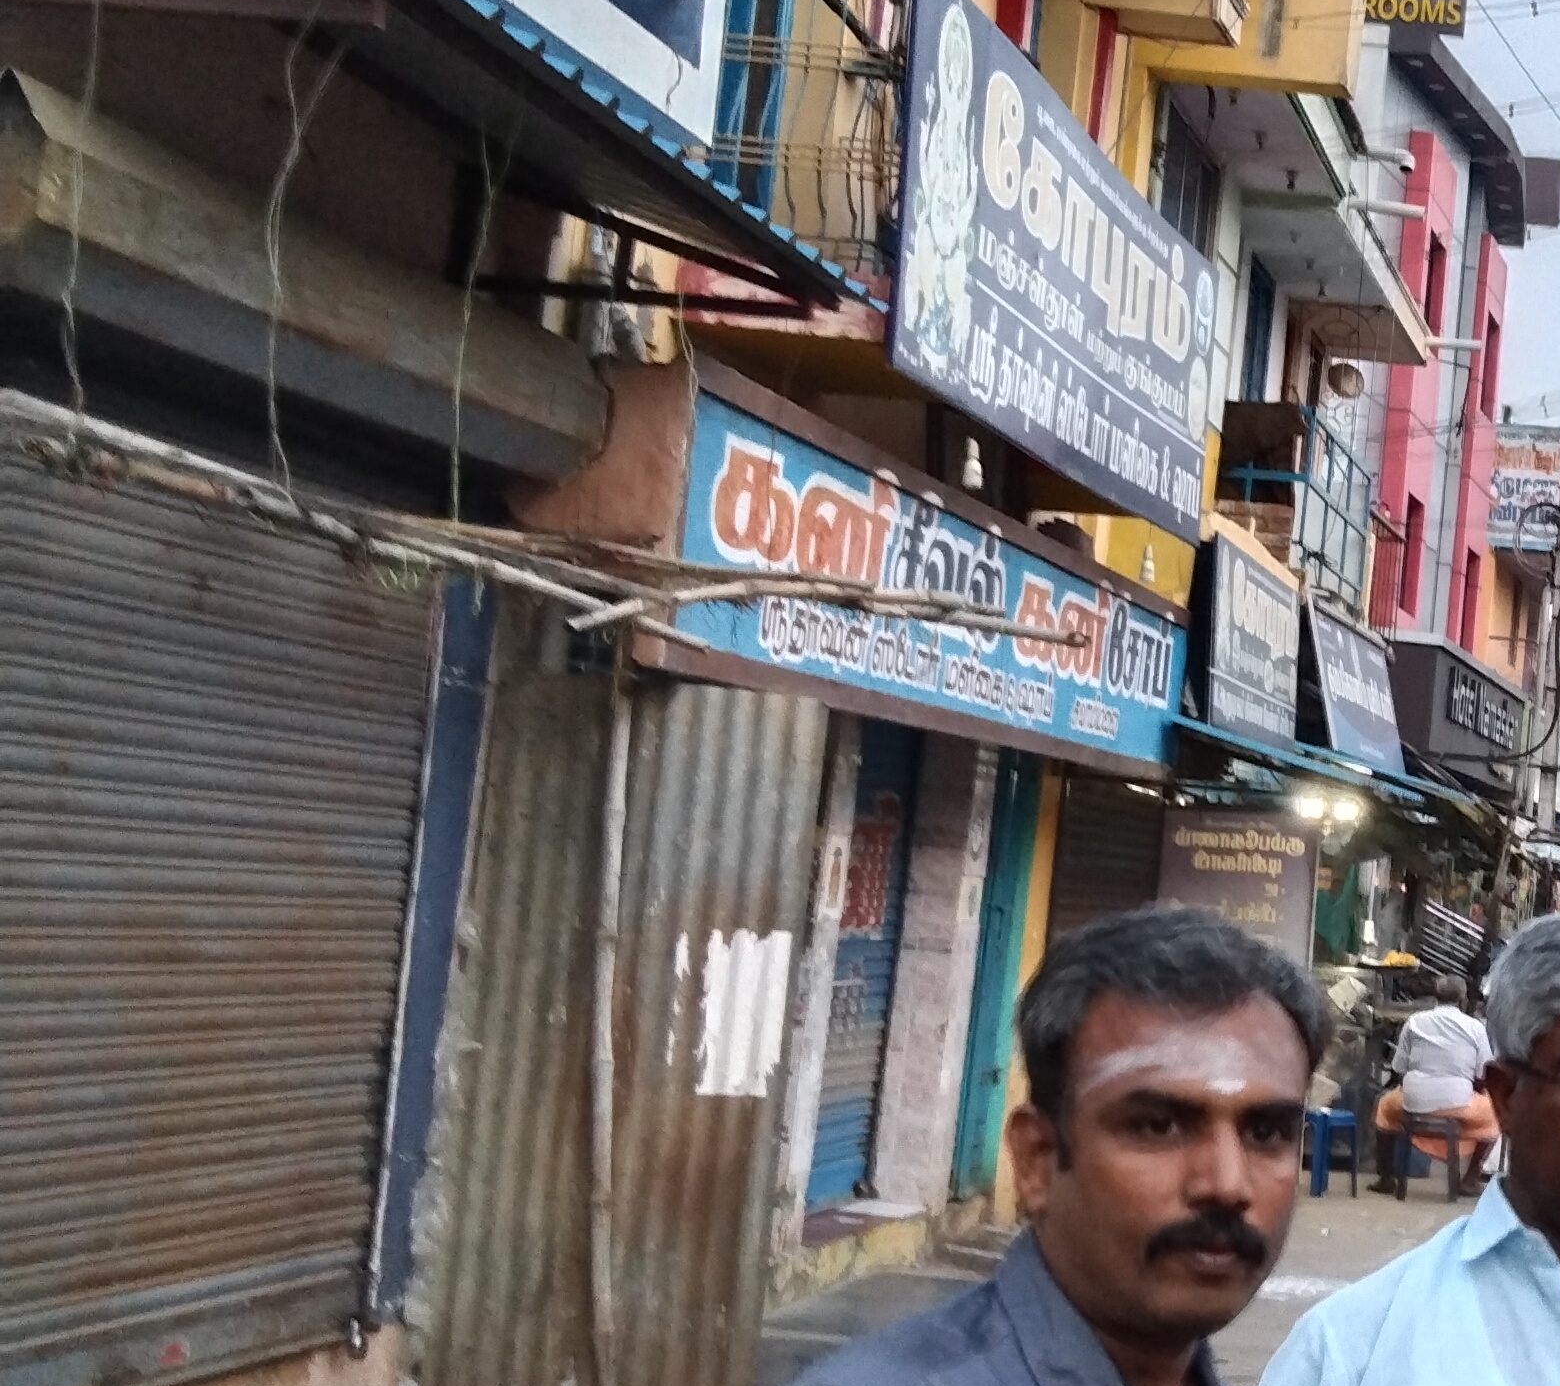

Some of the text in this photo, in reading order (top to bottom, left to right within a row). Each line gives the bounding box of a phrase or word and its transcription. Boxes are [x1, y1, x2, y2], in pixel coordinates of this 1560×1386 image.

[982, 69, 1193, 364] கோபுரம்
[1160, 445, 1170, 502] &
[1450, 666, 1478, 730] Hotel
